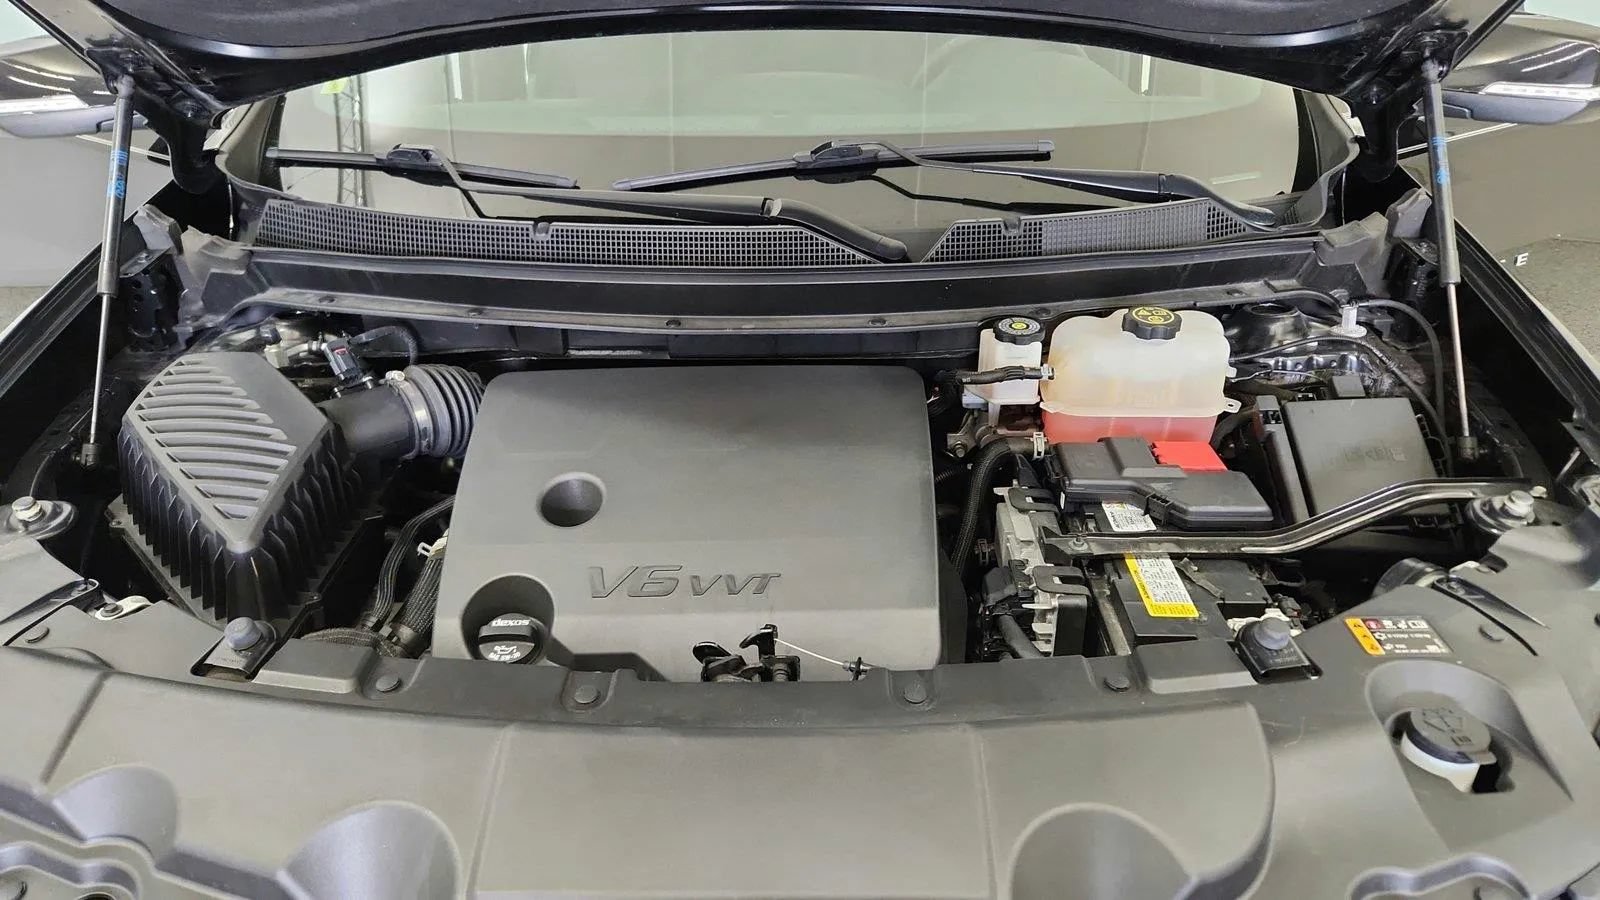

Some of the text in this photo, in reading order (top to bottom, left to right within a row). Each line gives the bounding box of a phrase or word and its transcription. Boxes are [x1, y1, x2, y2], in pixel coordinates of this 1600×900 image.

[588, 564, 782, 599] V6 VVT
[491, 618, 531, 627] dexos
